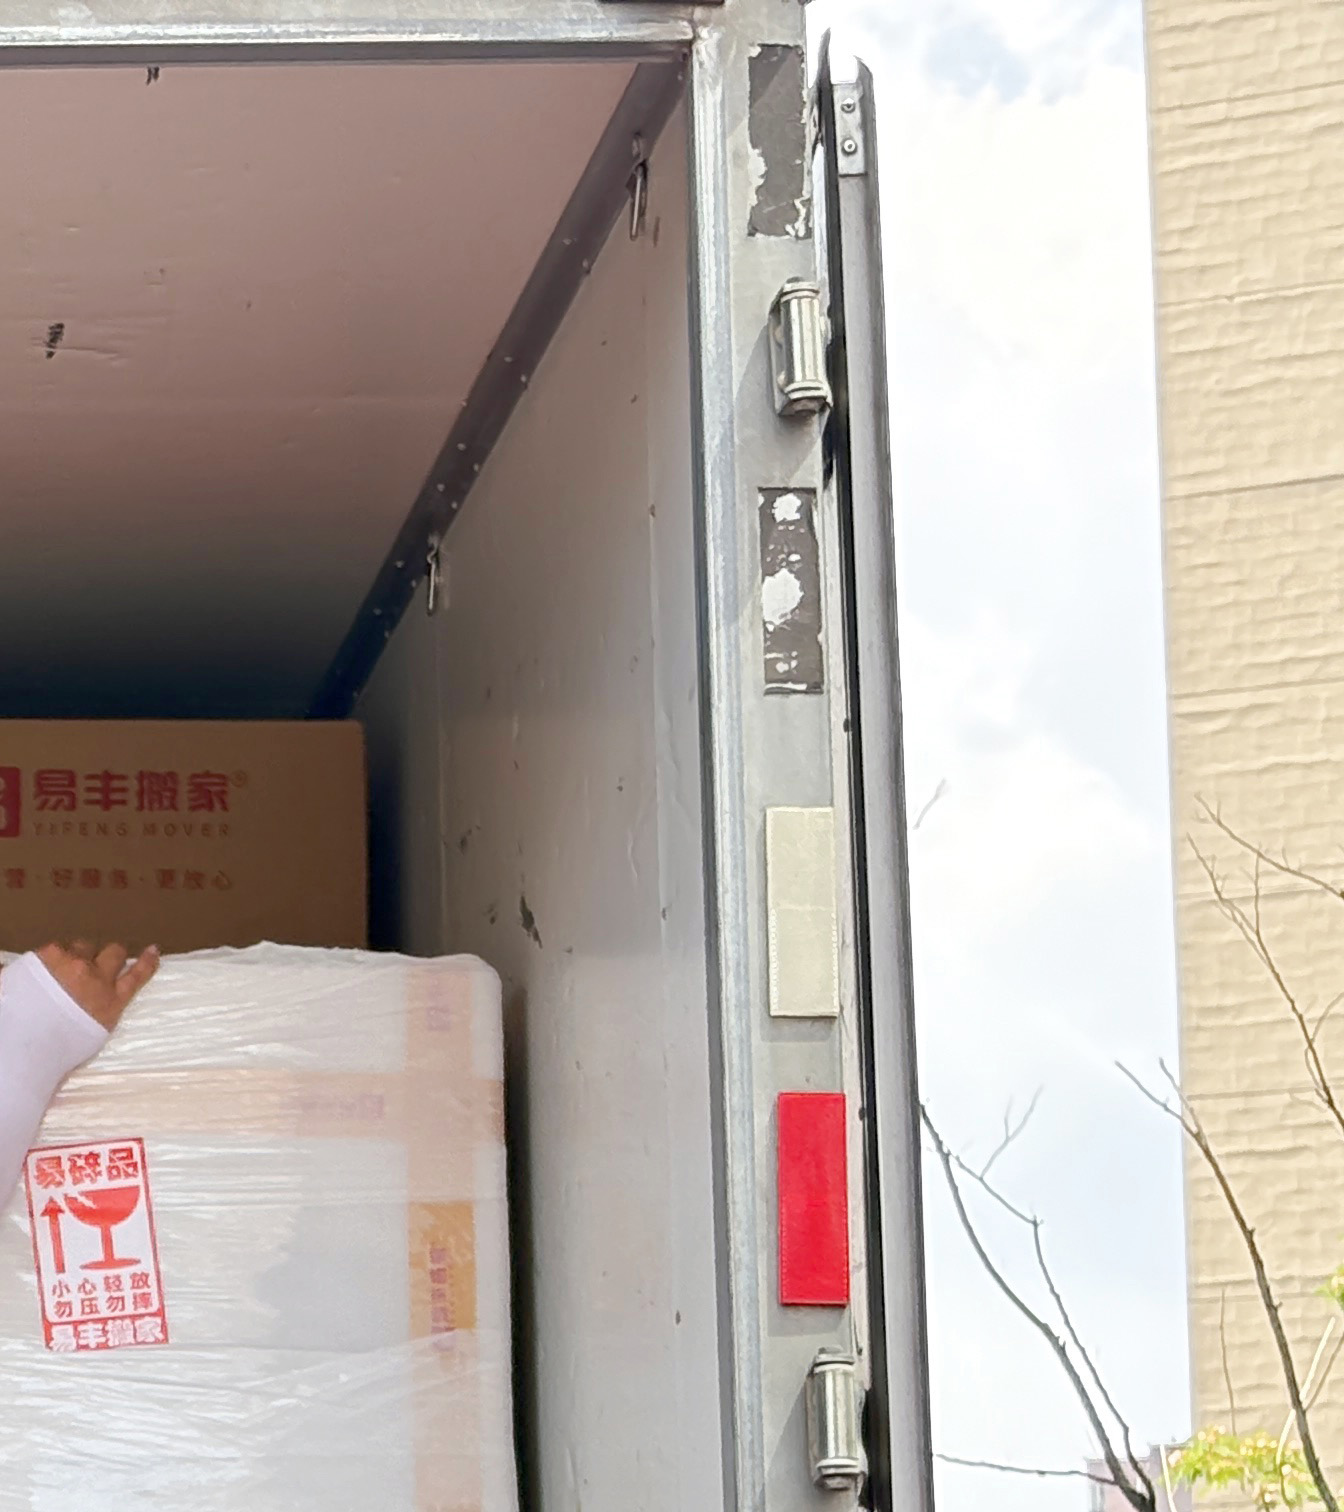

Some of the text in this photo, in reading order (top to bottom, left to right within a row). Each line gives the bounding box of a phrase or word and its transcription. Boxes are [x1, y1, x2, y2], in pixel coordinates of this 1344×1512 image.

[33, 1147, 139, 1189] 易碎品
[52, 1271, 150, 1299] 小心轻放
[50, 1316, 163, 1351] 易丰搬家
